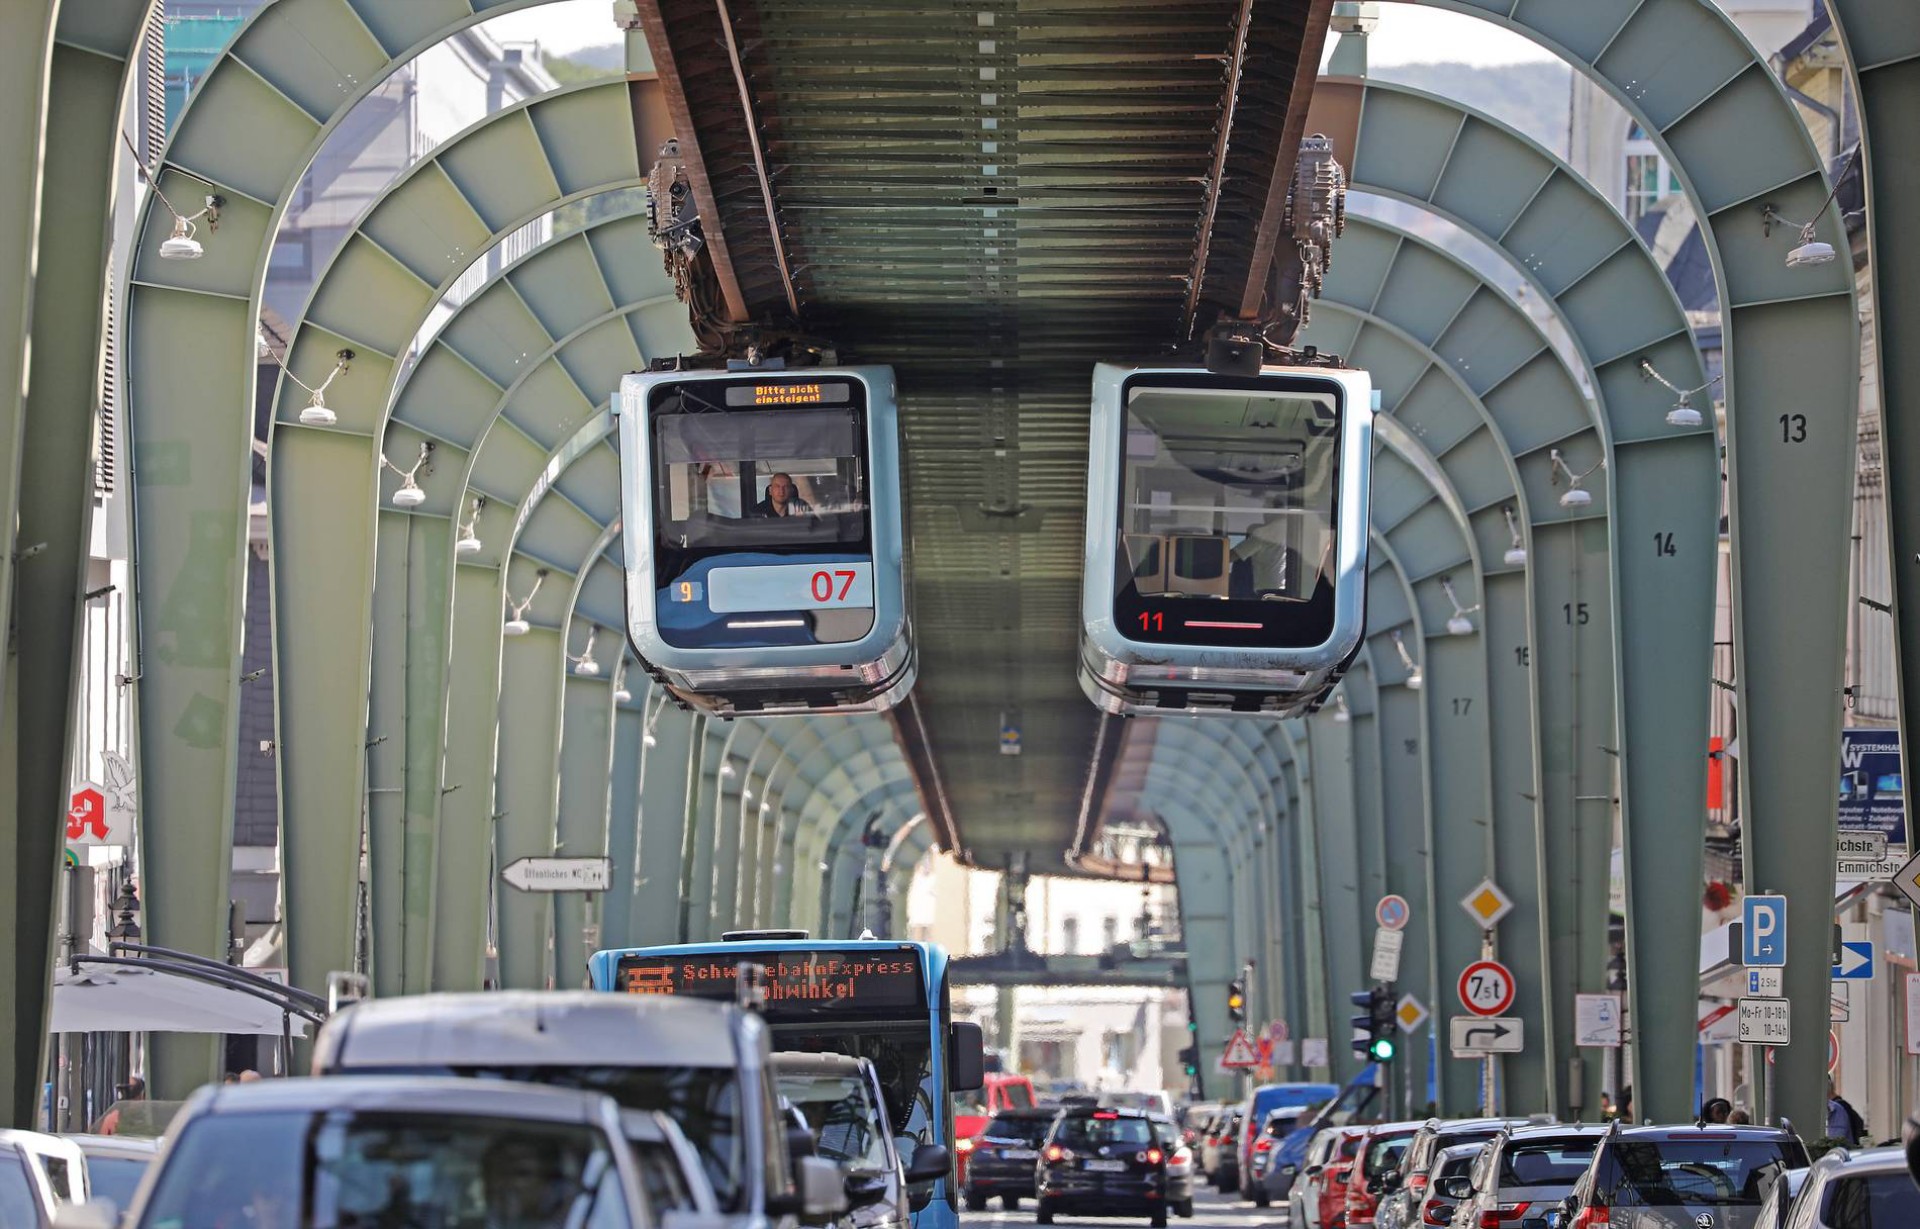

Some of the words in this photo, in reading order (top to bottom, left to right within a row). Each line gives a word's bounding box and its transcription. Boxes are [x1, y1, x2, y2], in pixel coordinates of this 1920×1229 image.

[755, 386, 786, 396] Bitte
[789, 384, 820, 394] nicht
[755, 394, 820, 405] einsteigen!
[1779, 413, 1807, 443] 13
[1653, 532, 1677, 557] 14
[680, 582, 692, 602] 9
[811, 570, 856, 602] 07
[1138, 611, 1164, 631] 11
[1563, 603, 1589, 625] 15
[1452, 698, 1472, 716] 17
[1849, 743, 1900, 753] SYSTEMHA
[1836, 839, 1873, 852] ichstr.
[1753, 905, 1776, 957] P
[683, 960, 914, 981] SchwebahnExpress
[1741, 1005, 1763, 1019] Mo-Fr
[1741, 1022, 1750, 1036] Sa
